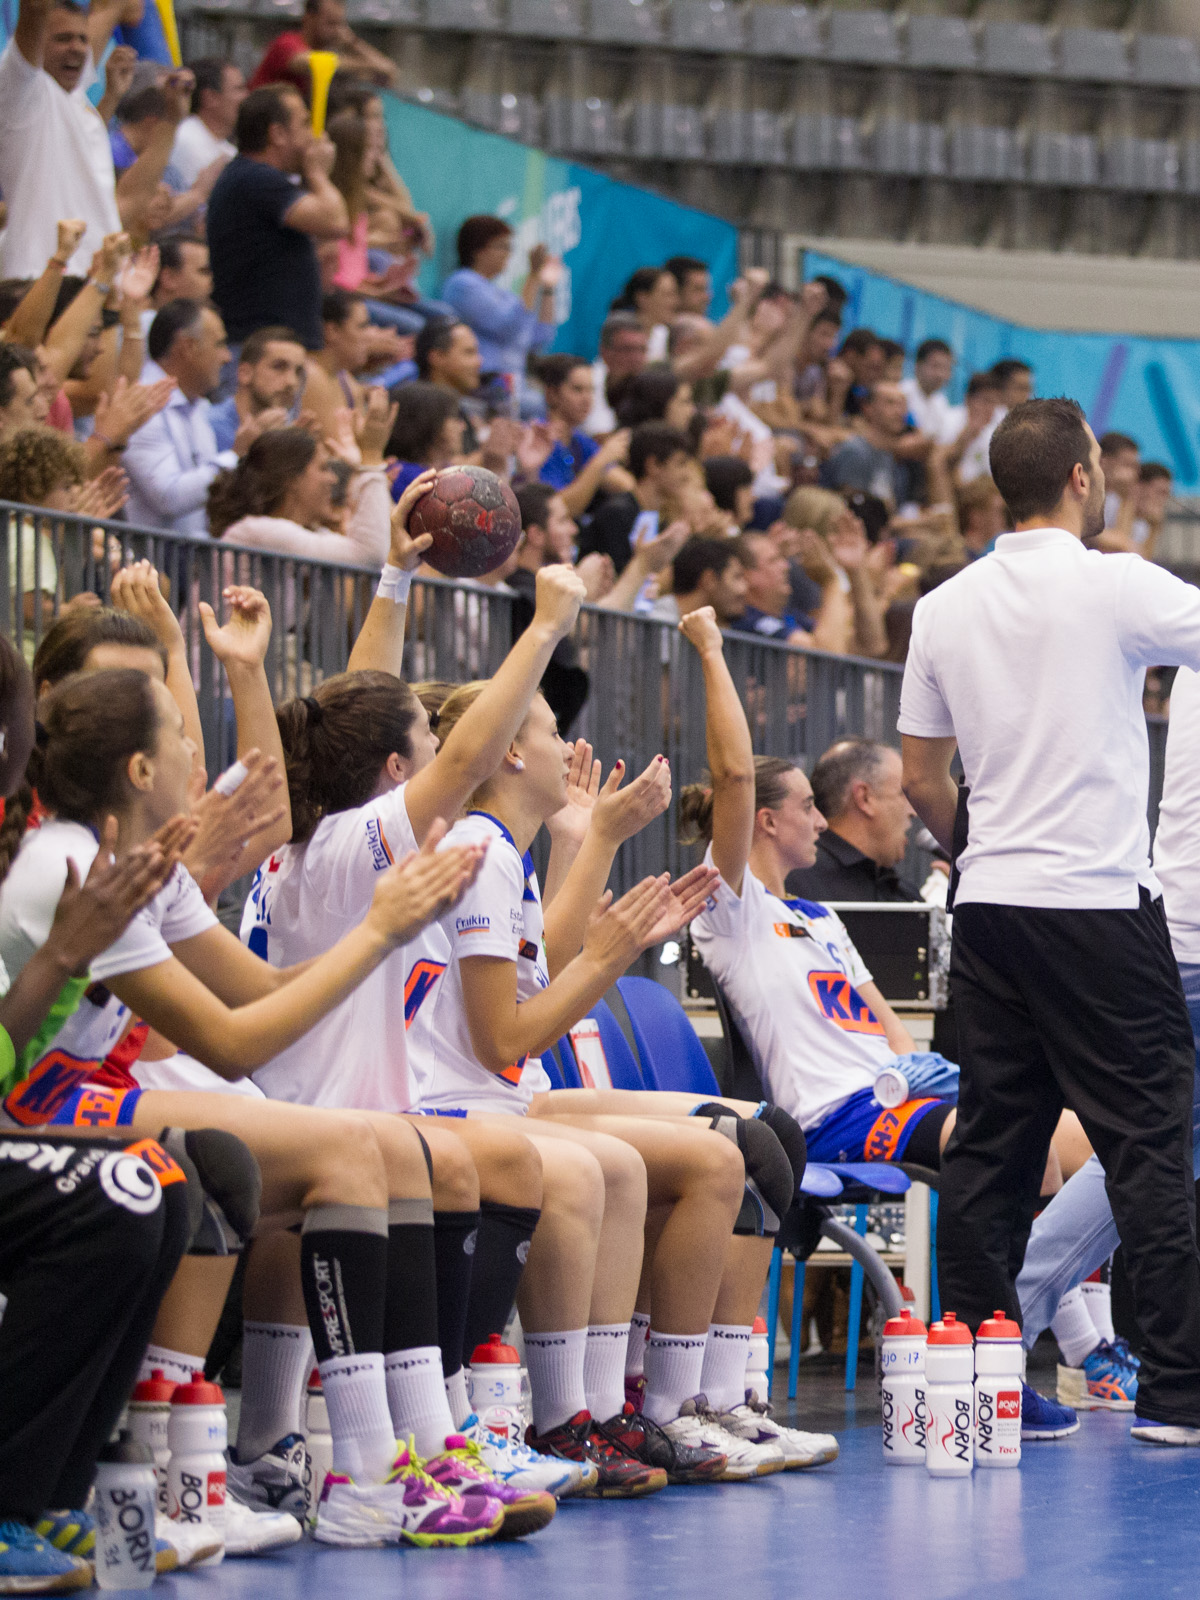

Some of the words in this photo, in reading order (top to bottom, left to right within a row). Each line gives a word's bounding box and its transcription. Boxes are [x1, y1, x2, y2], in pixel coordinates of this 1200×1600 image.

[955, 1399, 970, 1462] BORN
[978, 1391, 993, 1454] BORN
[110, 1488, 155, 1572] BORN
